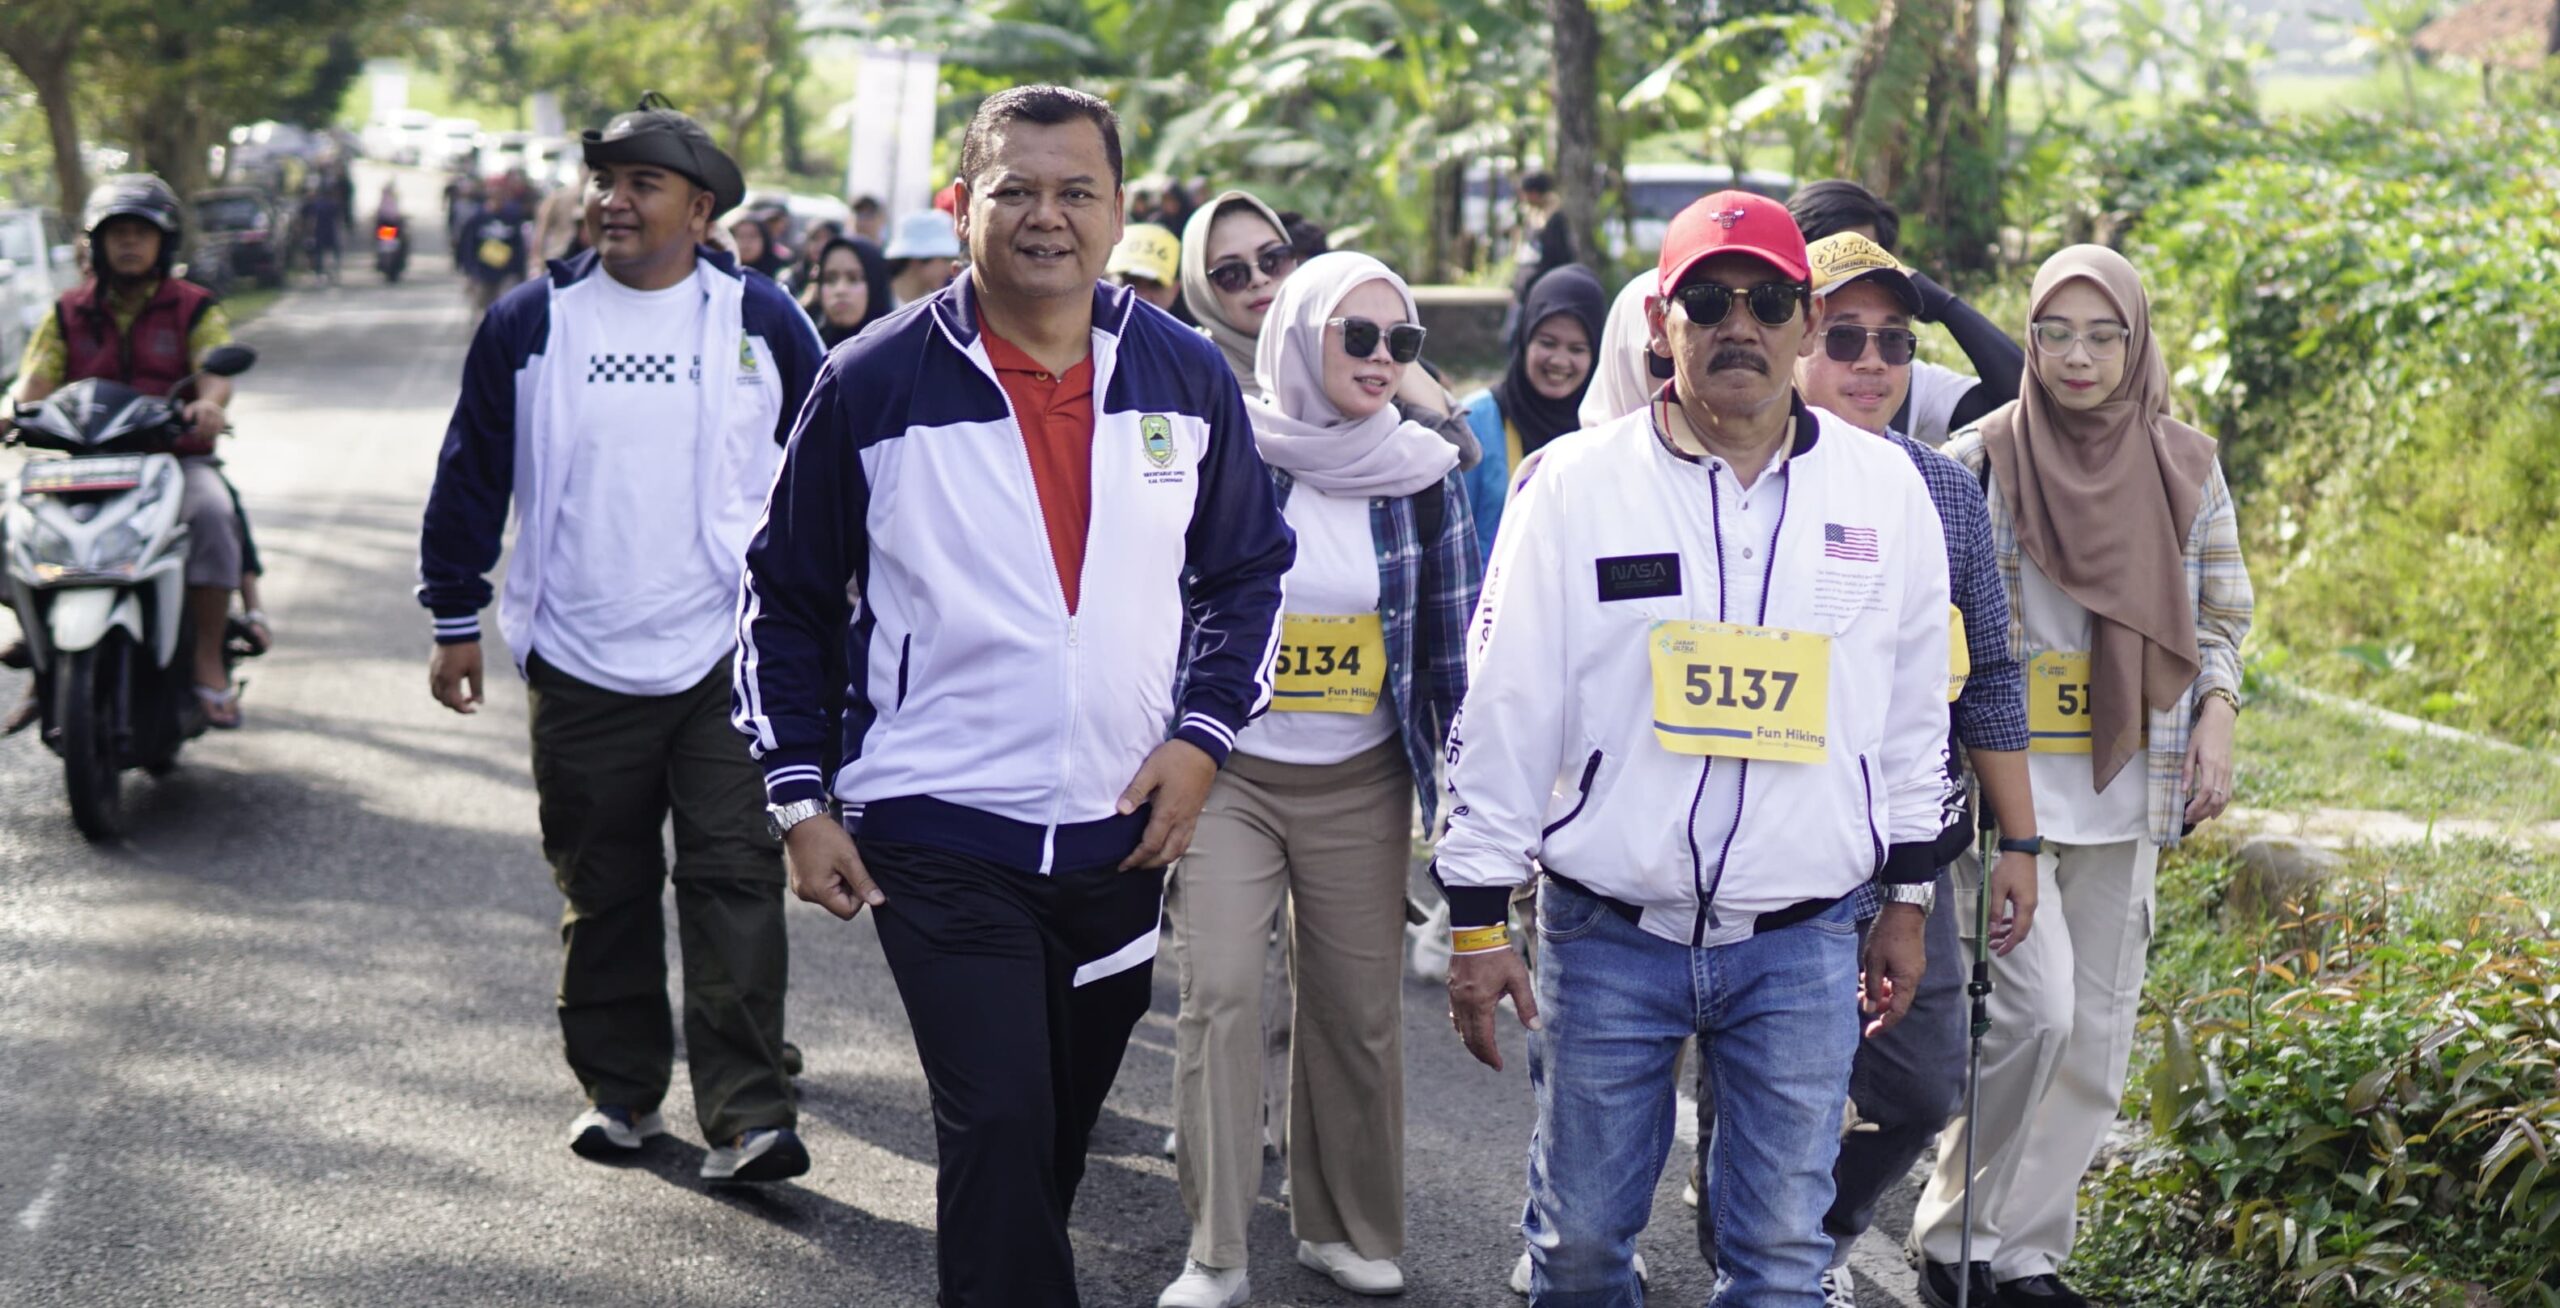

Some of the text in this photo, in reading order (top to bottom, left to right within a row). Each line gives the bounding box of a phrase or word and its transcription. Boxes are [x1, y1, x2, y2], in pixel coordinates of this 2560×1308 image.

[1610, 562, 1667, 581] NASA
[1275, 645, 1361, 676] 5134
[1327, 687, 1348, 696] Fun
[1684, 664, 1799, 712] 5137
[1756, 726, 1782, 739] Fun
[1785, 727, 1826, 748] Hiking
